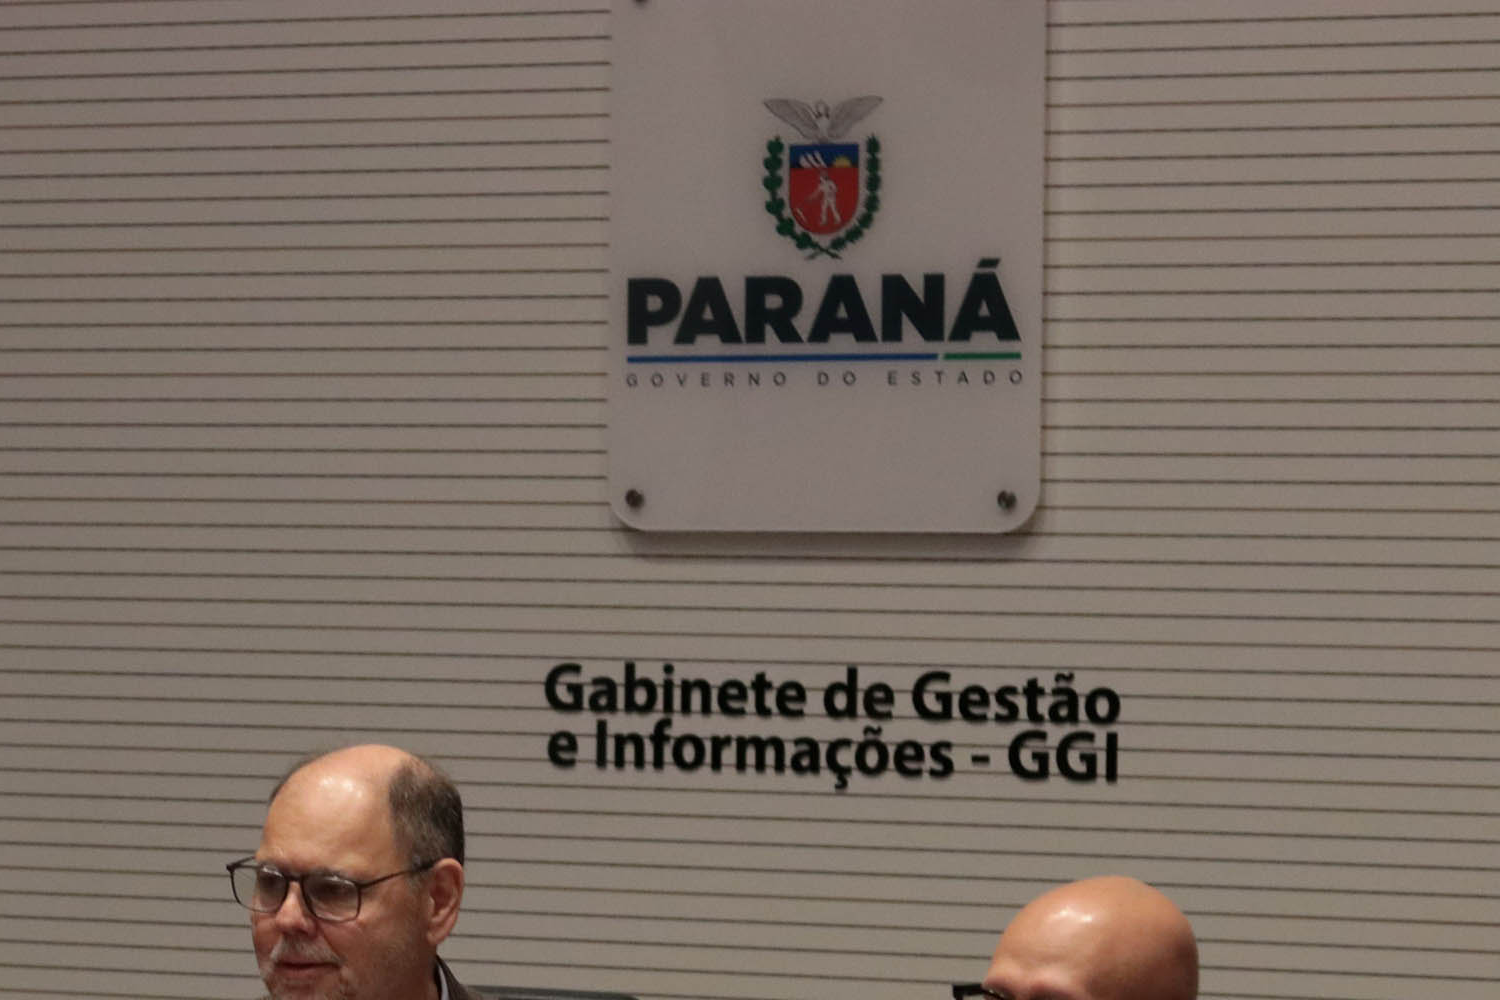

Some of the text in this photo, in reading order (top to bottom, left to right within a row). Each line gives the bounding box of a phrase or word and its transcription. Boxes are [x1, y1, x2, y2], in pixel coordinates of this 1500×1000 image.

[627, 257, 1022, 345] PARANÁ
[626, 369, 1023, 388] GOVERNO DO ESTADO
[544, 661, 1121, 726] Gabinete de Gestão
[547, 728, 579, 769] e
[595, 716, 955, 791] Informações
[1008, 729, 1119, 784] GGI
